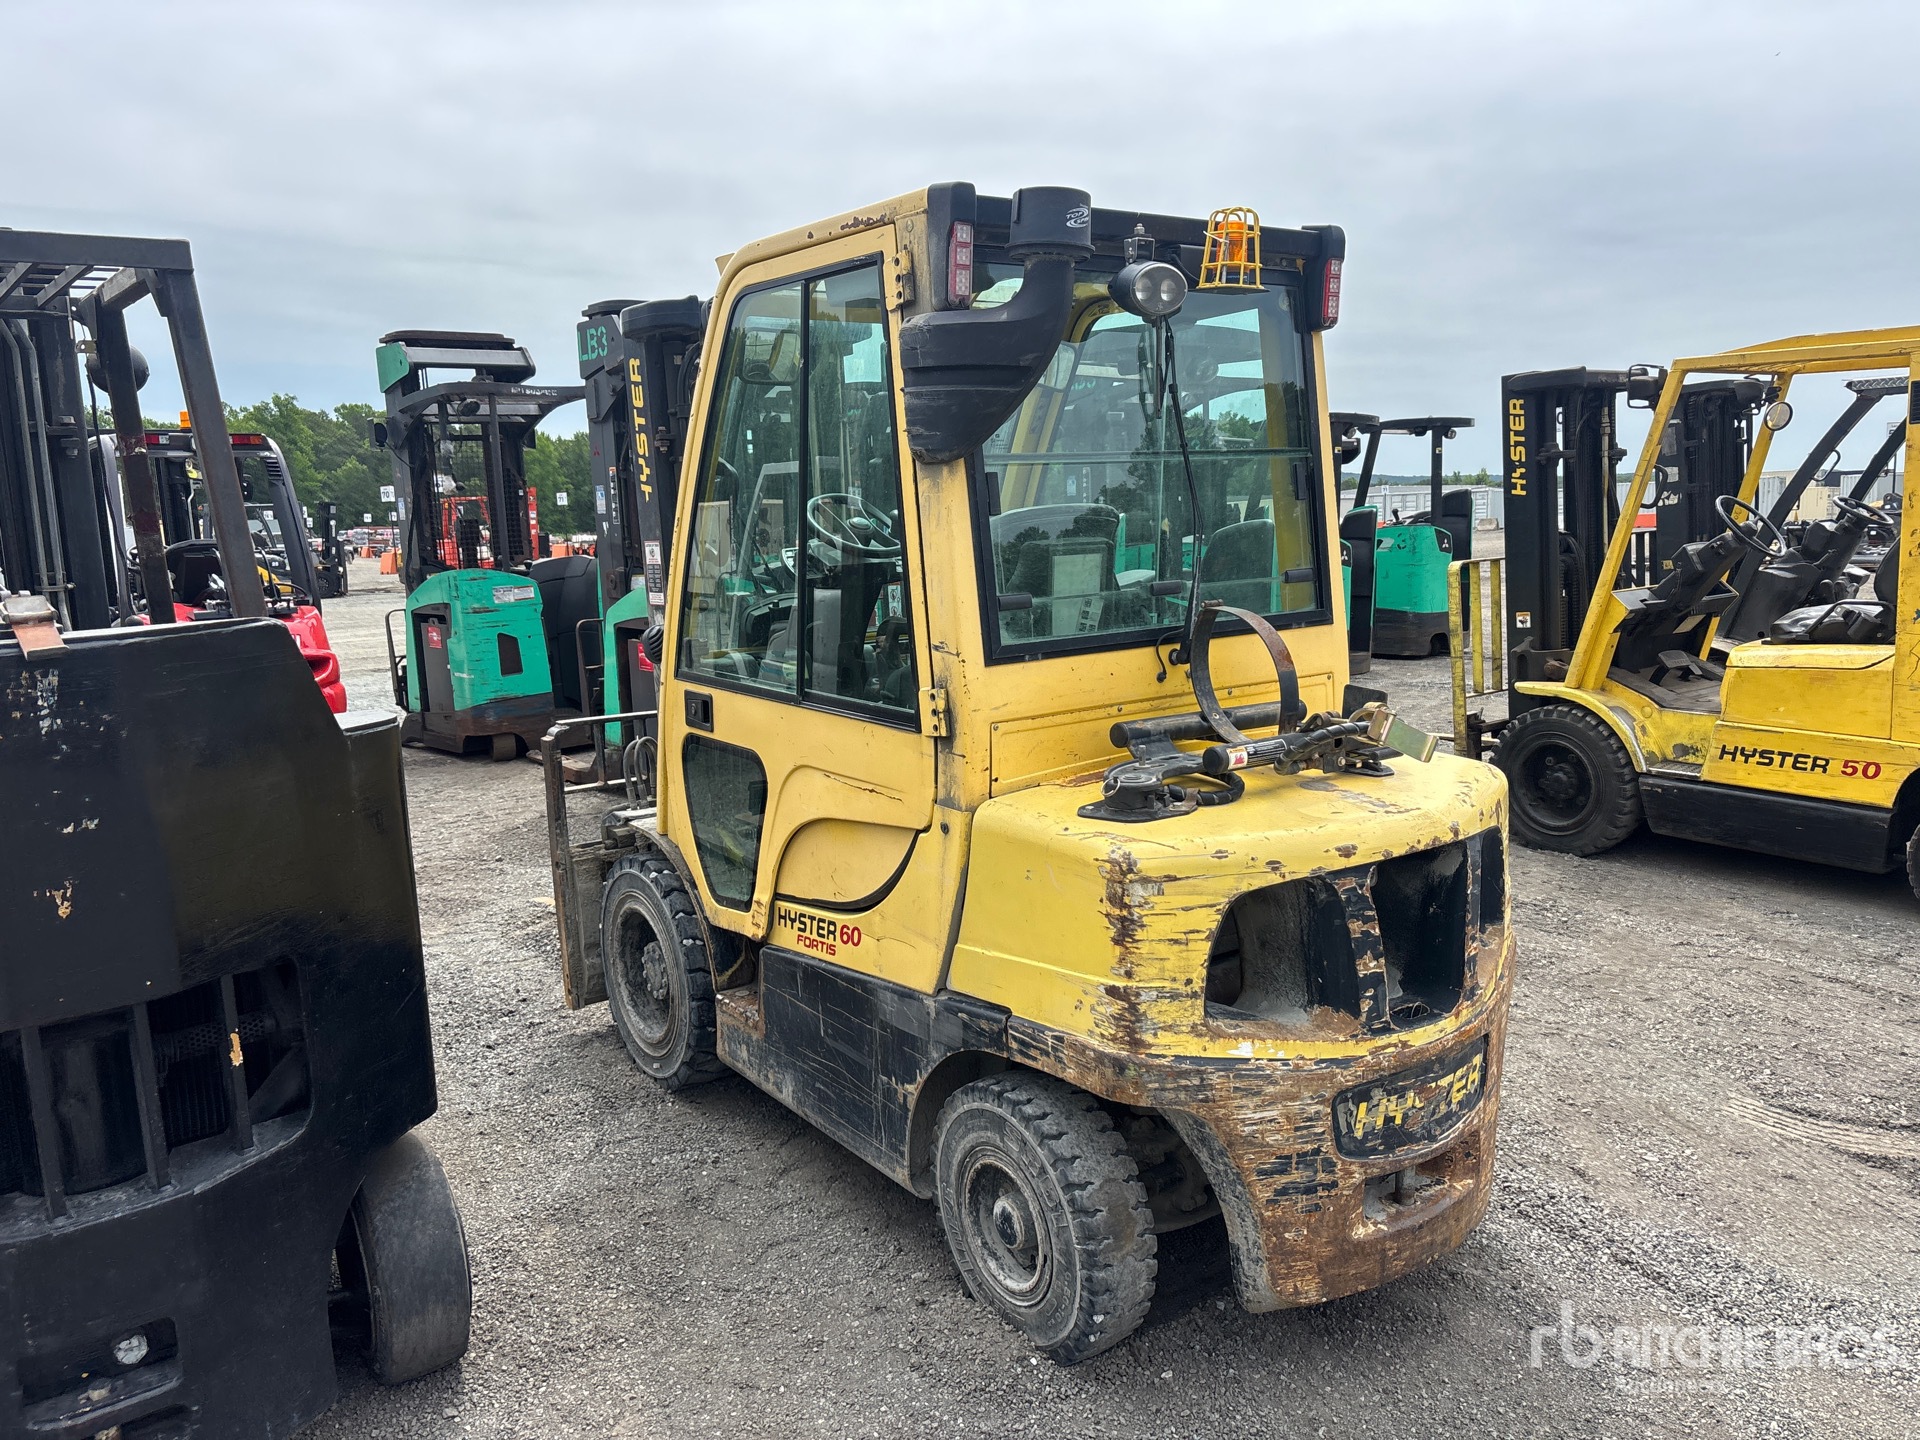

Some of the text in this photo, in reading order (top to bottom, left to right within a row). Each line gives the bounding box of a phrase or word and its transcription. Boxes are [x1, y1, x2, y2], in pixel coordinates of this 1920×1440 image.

[577, 325, 608, 362] LB3
[1509, 398, 1527, 496] HYSTER
[1718, 744, 1882, 780] HYSTER 50
[777, 906, 862, 947] HYSTER 60
[796, 933, 837, 957] FORTIS
[1353, 1053, 1483, 1140] HYTER
